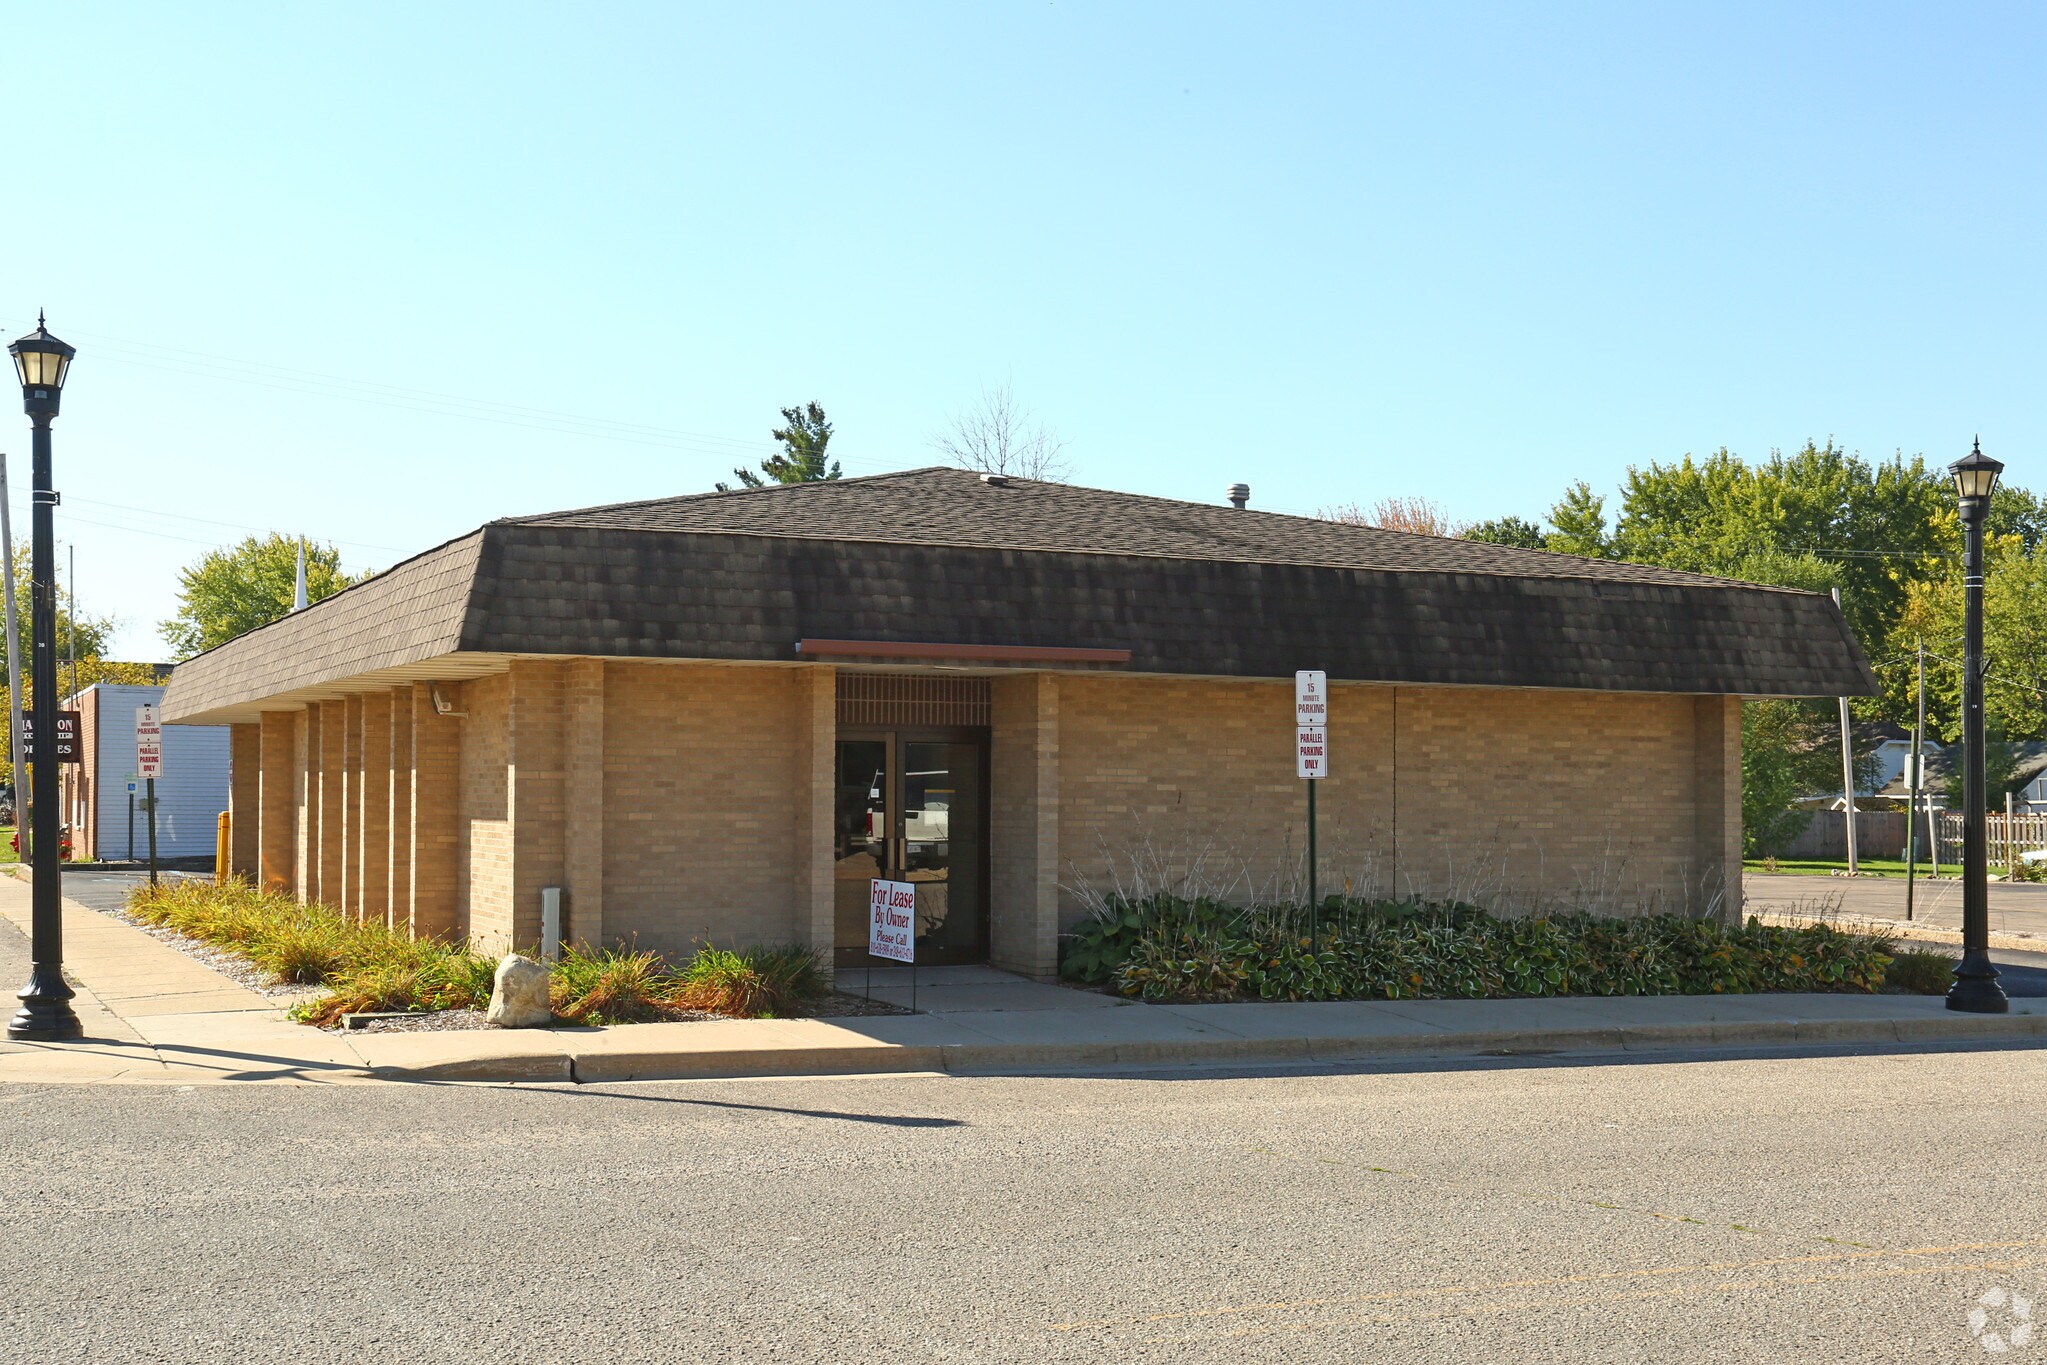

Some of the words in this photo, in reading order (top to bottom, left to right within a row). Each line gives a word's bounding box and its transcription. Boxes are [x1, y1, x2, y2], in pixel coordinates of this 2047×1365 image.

[1307, 683, 1315, 693] 15
[1298, 704, 1324, 714] PARKING
[1300, 734, 1323, 743] PARALLEL
[1300, 746, 1323, 756] PARKING
[1304, 759, 1318, 769] ONLY
[872, 881, 888, 904] For
[889, 883, 914, 909] Lease
[875, 906, 885, 928] By
[886, 908, 910, 928] Owner
[876, 930, 894, 944] Please
[896, 933, 908, 946] Call
